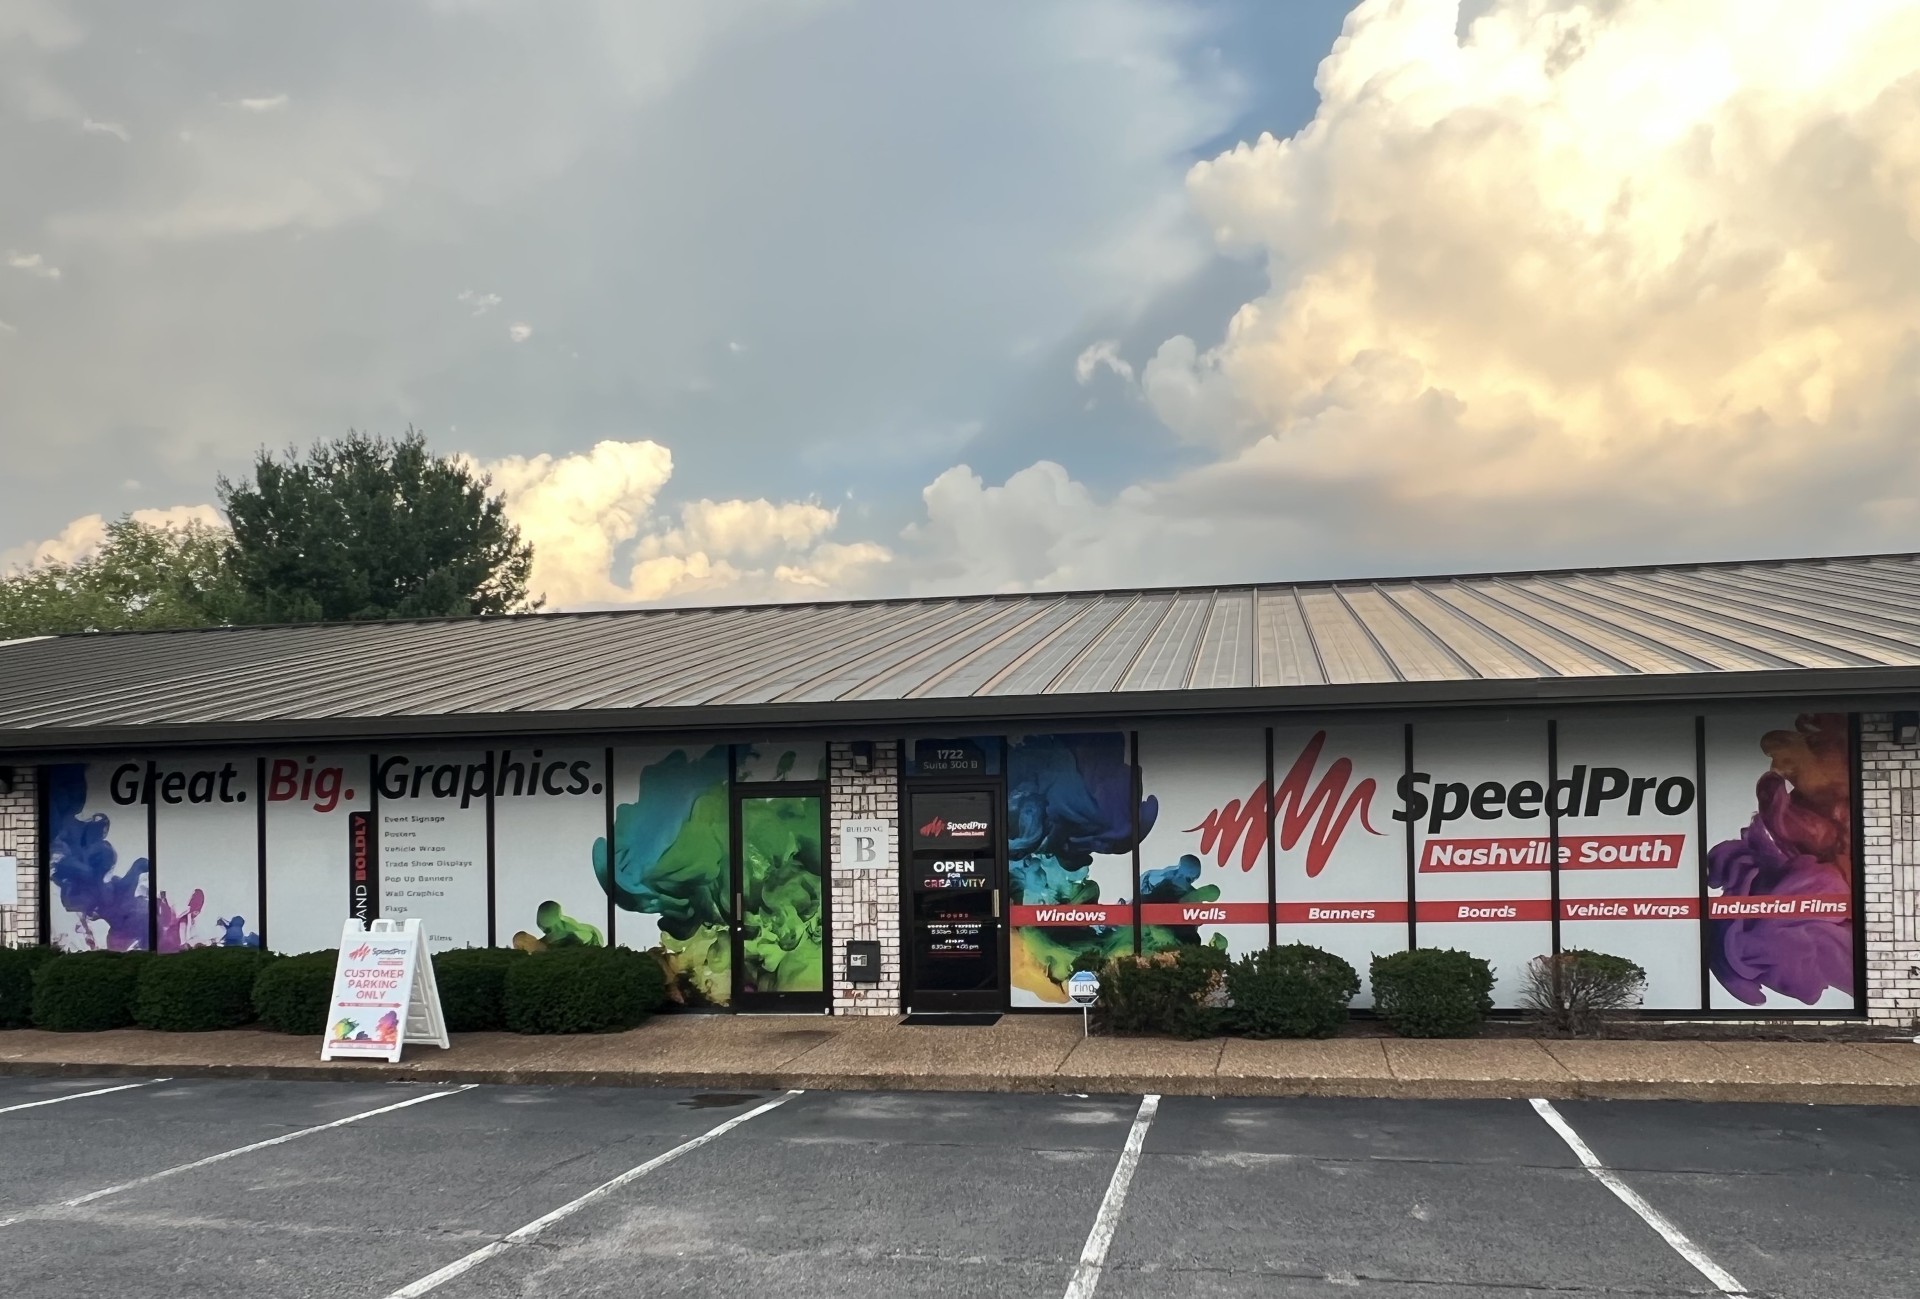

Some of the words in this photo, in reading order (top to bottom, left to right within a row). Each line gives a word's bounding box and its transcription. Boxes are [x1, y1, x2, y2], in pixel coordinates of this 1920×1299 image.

[937, 749, 964, 760] 1722
[923, 761, 948, 769] Suite
[950, 760, 968, 769] 300
[110, 762, 247, 806] Great.
[267, 755, 355, 813] Big.
[377, 749, 603, 809] Graphics.
[1392, 764, 1696, 834] SpeedPro
[411, 815, 445, 823] Signage
[946, 821, 988, 832] SpeedPro
[355, 816, 366, 881] BOLDLY
[854, 836, 876, 863] B
[1578, 841, 1672, 864] South
[437, 860, 473, 868] Displays
[933, 861, 975, 873] OPEN
[924, 878, 986, 888] CREATIVITY
[406, 890, 445, 898] Graphics
[385, 905, 408, 913] Flags
[1457, 904, 1517, 919] Boards
[1565, 903, 1628, 917] Vehicle
[1633, 903, 1690, 918] Wraps
[1711, 900, 1796, 915] Industrial
[1799, 899, 1847, 914] Films
[1035, 909, 1107, 922] Windows
[1182, 907, 1227, 920] Walls
[1308, 907, 1376, 920] Banners
[372, 948, 407, 956] SpeedPro
[344, 969, 405, 979] CUSTOMER
[347, 979, 398, 989] PARKING
[1074, 983, 1095, 995] ring
[356, 990, 387, 1000] ONLY
